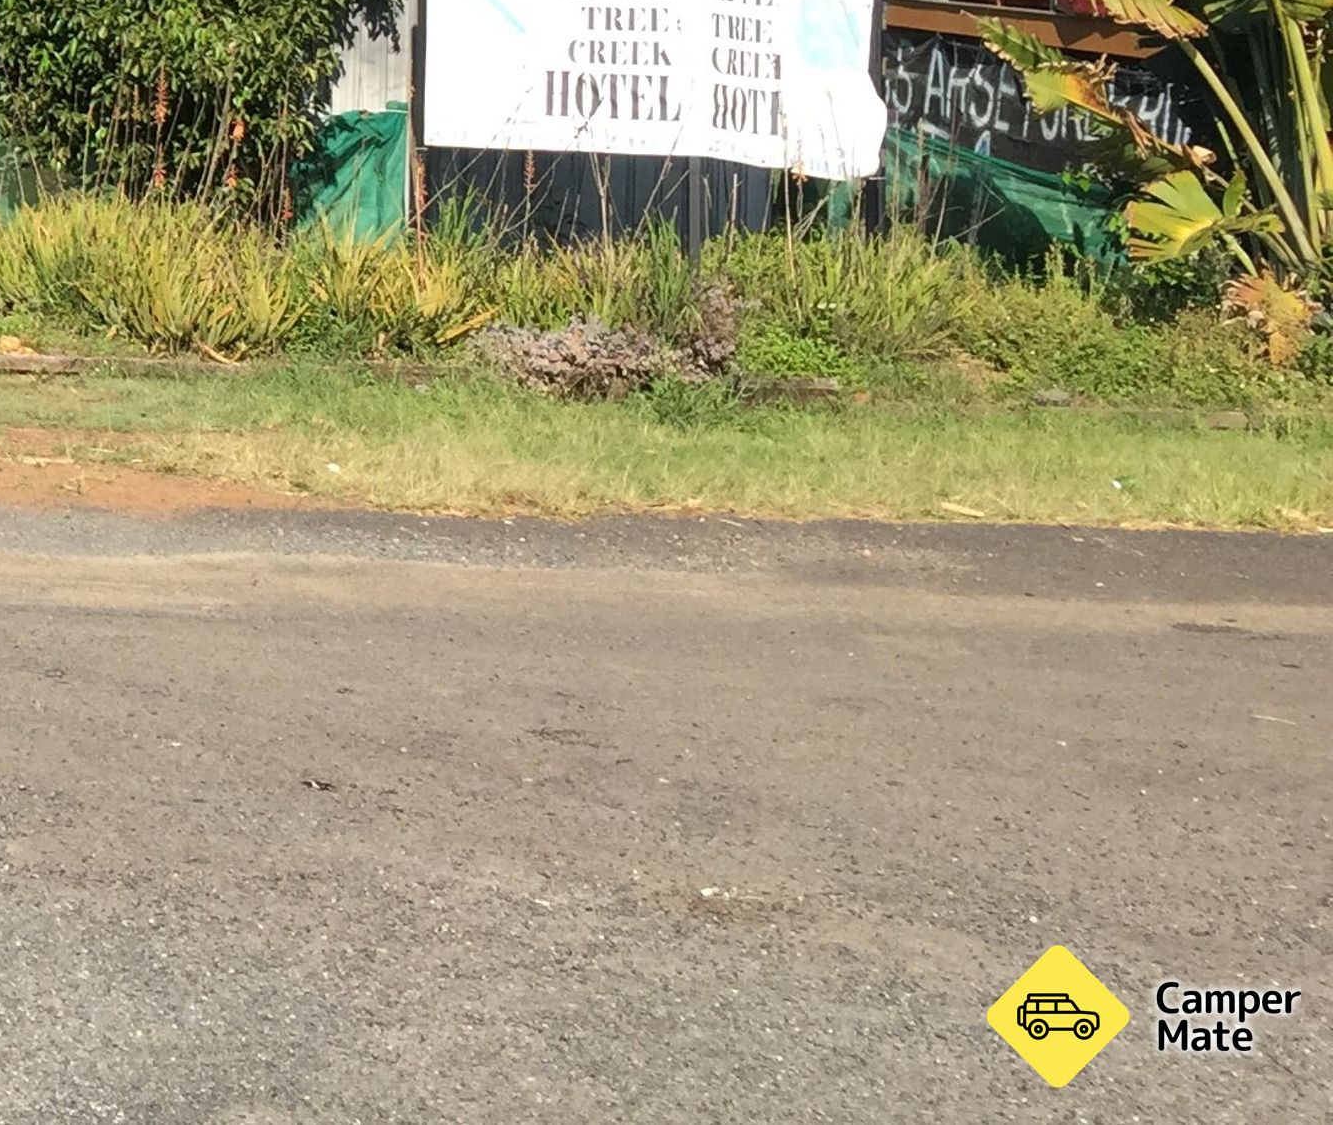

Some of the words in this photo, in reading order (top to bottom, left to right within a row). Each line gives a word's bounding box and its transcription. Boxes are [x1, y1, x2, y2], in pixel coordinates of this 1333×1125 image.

[581, 7, 669, 32] TREE
[711, 13, 773, 44] TREE
[568, 40, 672, 67] CREEK
[546, 70, 681, 122] HOTEL
